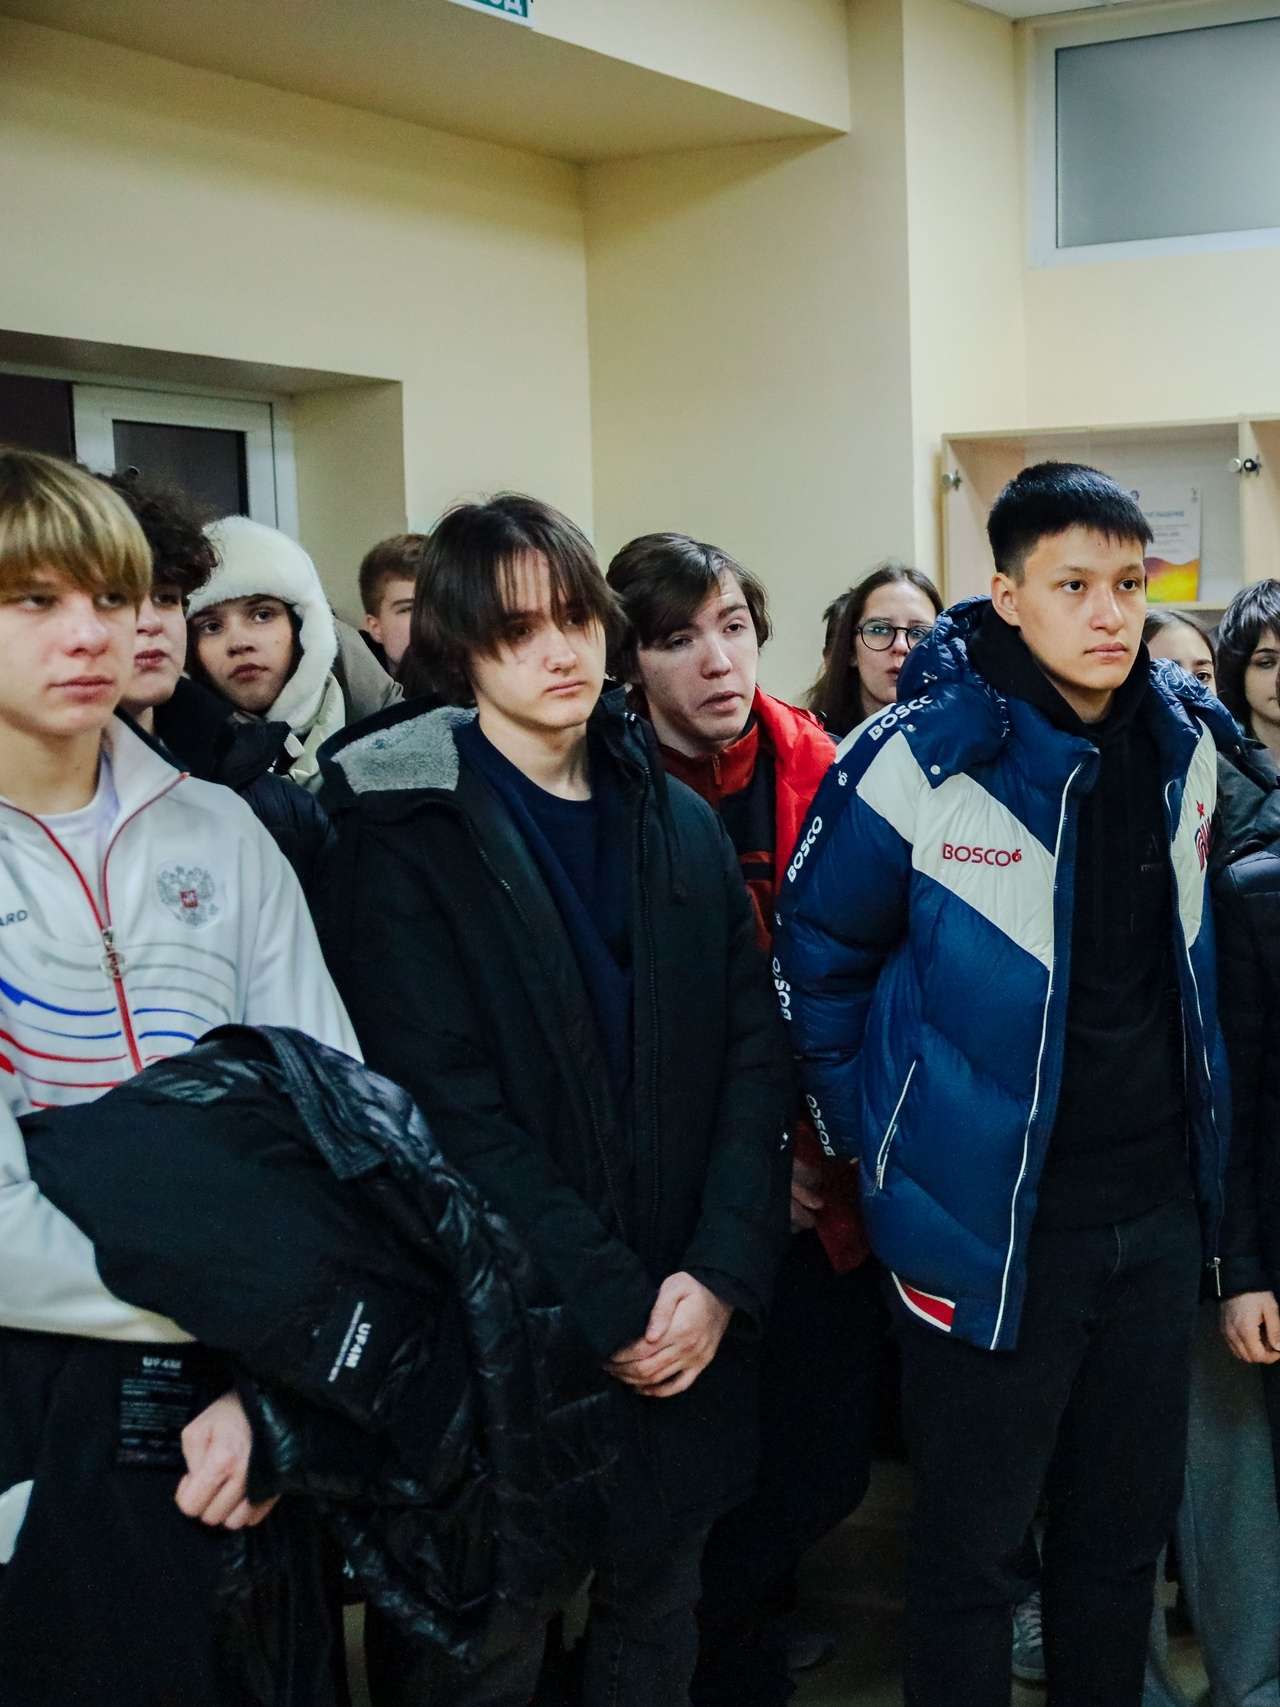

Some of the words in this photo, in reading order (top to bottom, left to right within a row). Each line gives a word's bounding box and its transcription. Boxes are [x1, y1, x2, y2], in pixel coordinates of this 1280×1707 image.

[786, 815, 823, 883] BOSCO
[942, 842, 1011, 868] BOSCO
[806, 1094, 836, 1157] BOSCO
